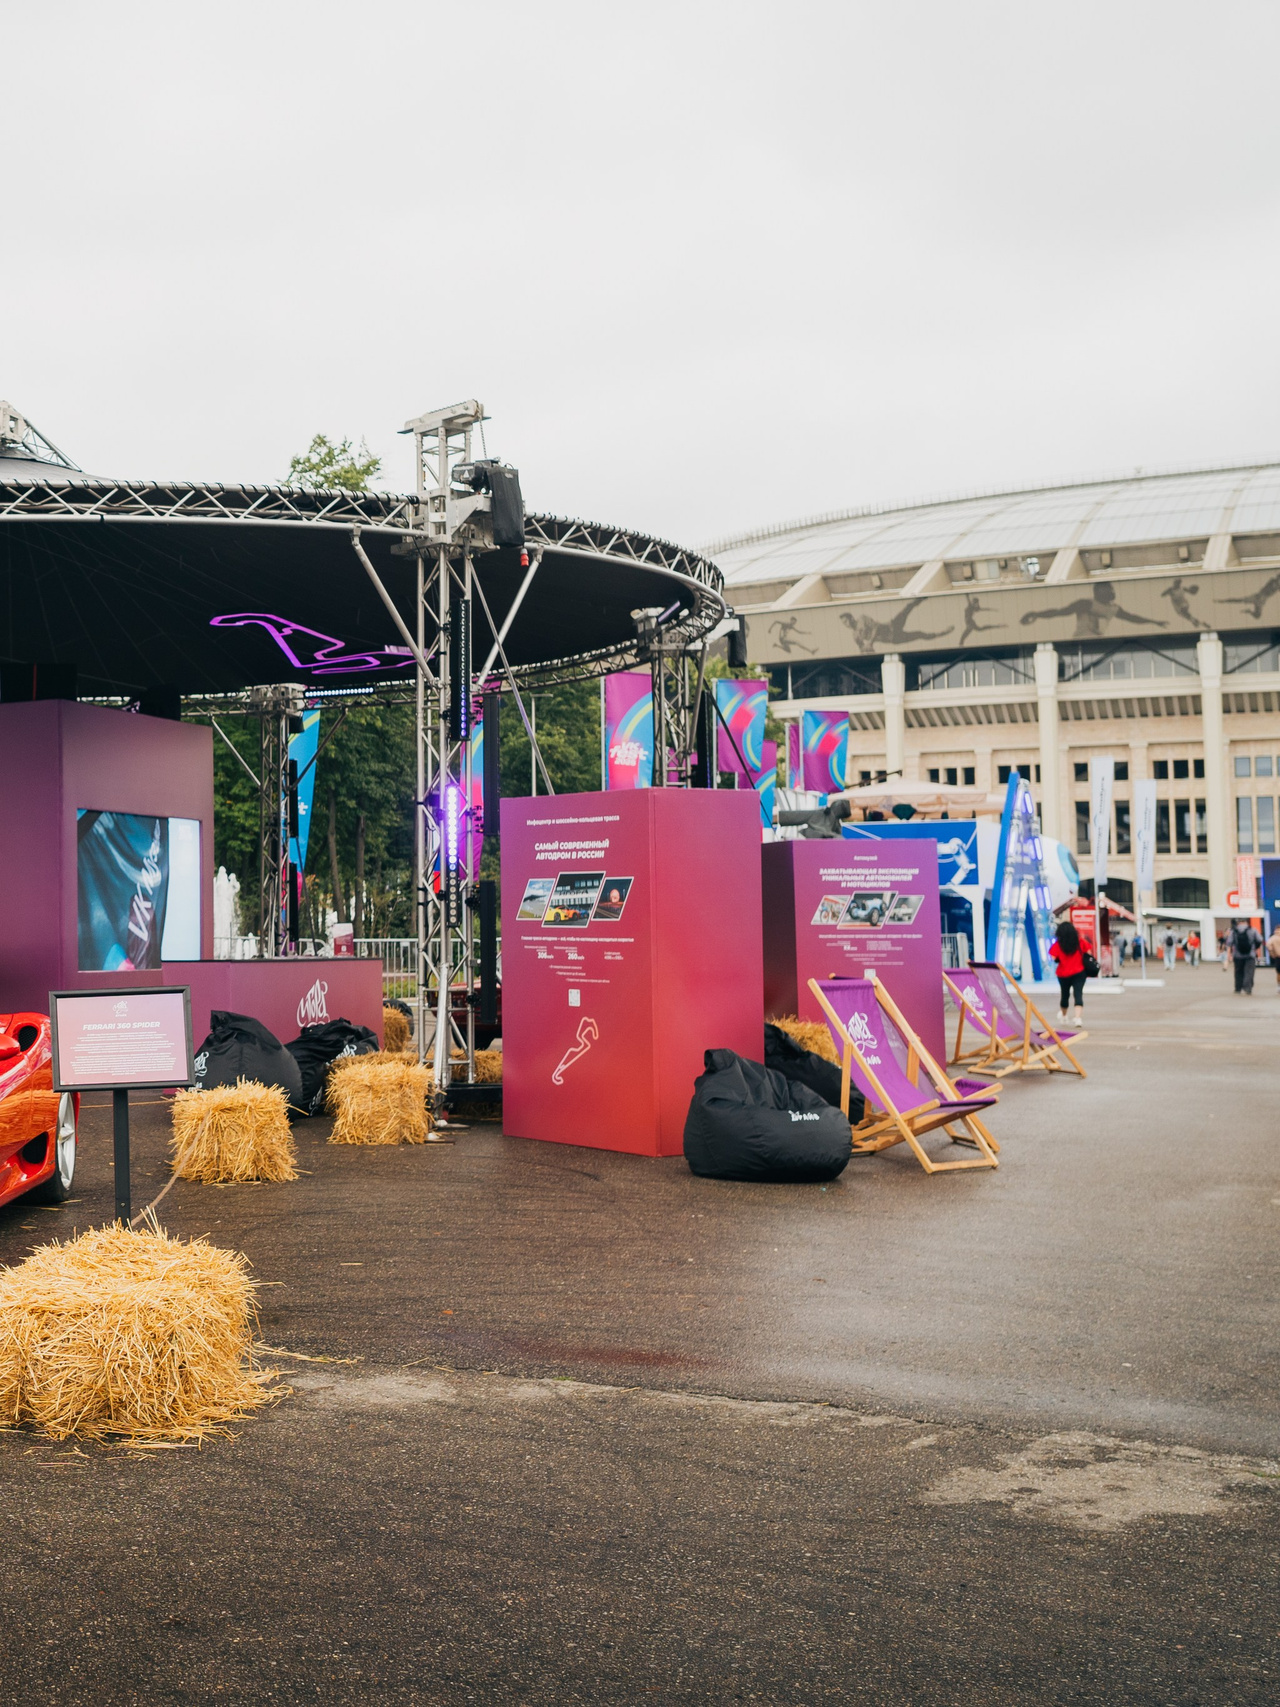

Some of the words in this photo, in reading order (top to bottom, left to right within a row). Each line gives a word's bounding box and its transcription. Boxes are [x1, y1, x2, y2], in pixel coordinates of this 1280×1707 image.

[526, 818, 552, 827] Инфоцентр
[604, 815, 620, 823] трасса
[535, 840, 559, 851] САМЫЙ
[559, 838, 610, 850] СОВРЕМЕННЫЙ
[536, 850, 571, 861] АВТОДРОМ
[572, 851, 577, 859] В
[577, 850, 604, 859] РОССИИ
[83, 1022, 116, 1031] FERRARI
[116, 1021, 132, 1029] 360
[132, 1020, 161, 1029] SPIDER
